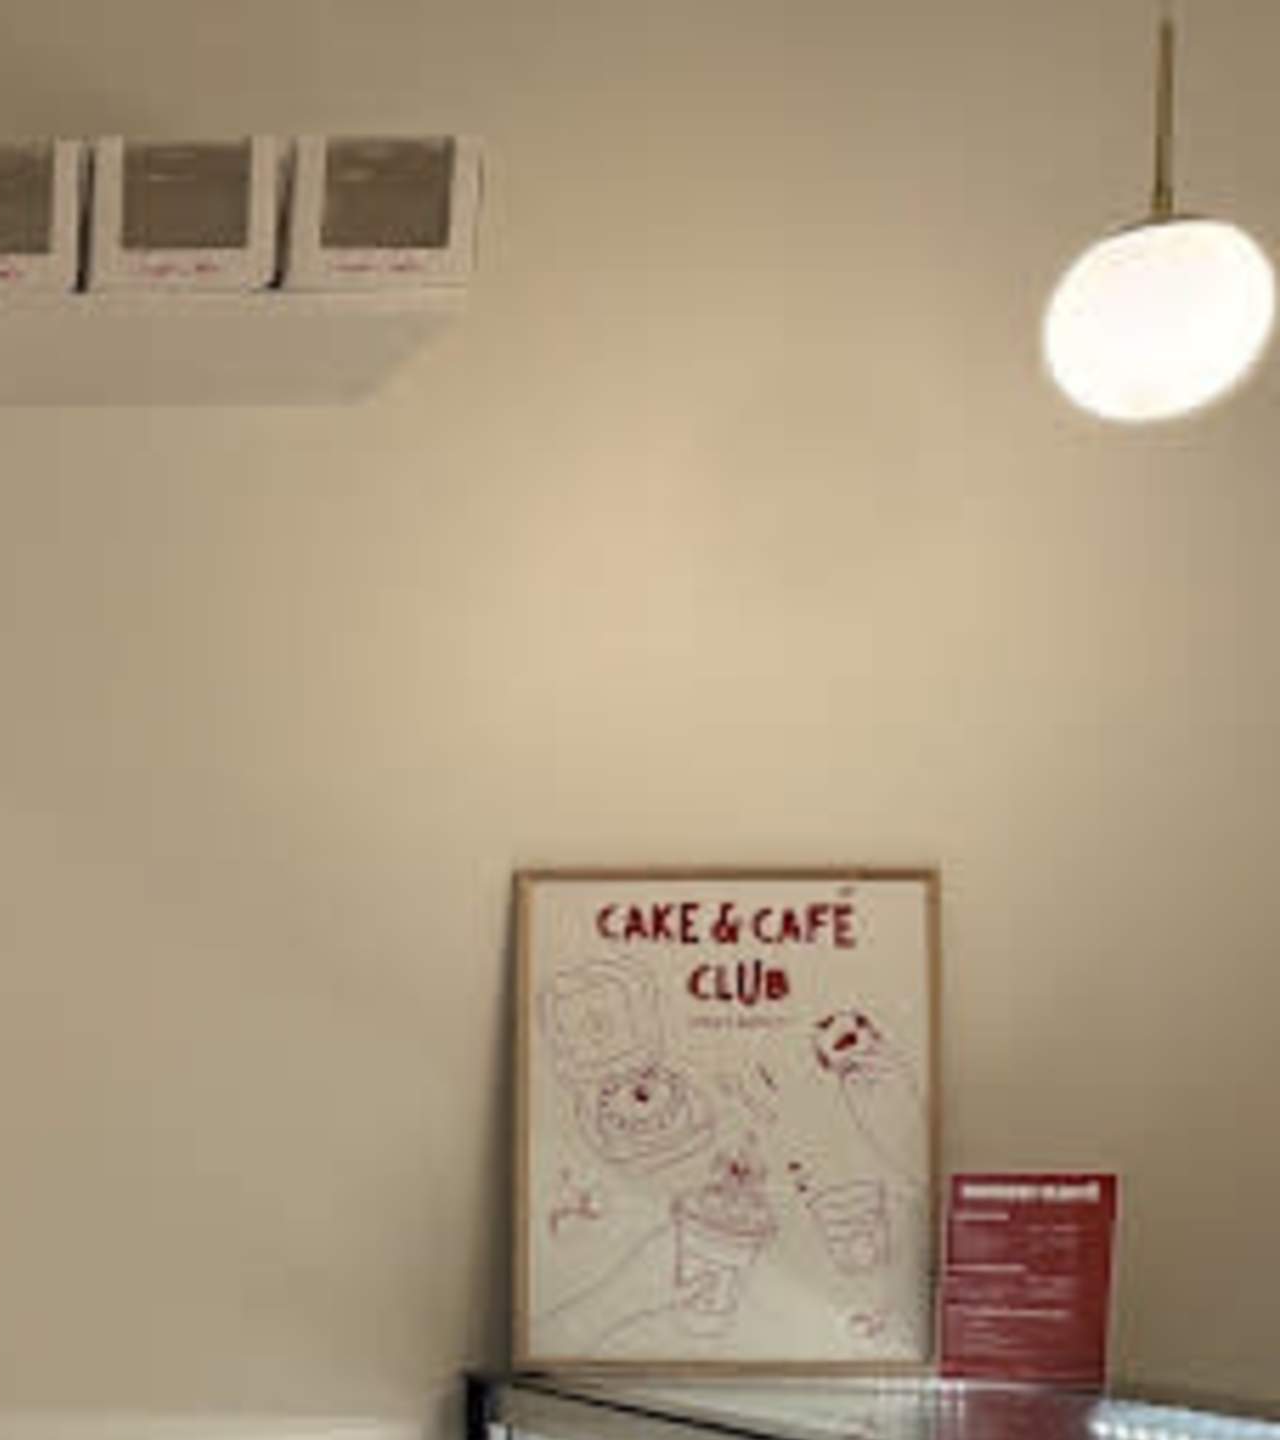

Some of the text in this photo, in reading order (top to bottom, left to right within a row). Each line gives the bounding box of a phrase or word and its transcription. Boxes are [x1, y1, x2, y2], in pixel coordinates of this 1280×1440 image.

[595, 886, 857, 950] CAKE & CAFÉ
[688, 959, 790, 1006] CLUB
